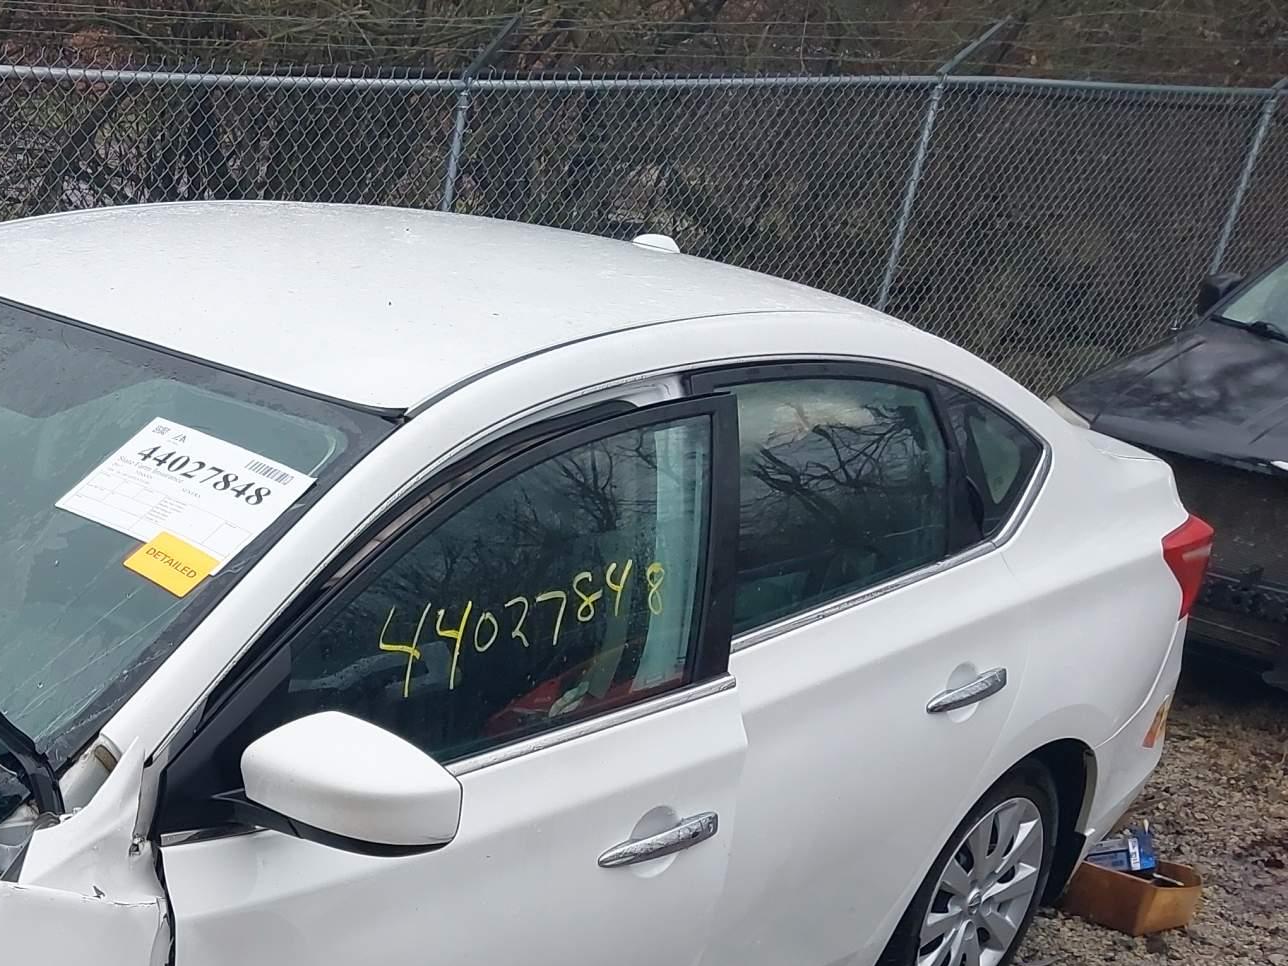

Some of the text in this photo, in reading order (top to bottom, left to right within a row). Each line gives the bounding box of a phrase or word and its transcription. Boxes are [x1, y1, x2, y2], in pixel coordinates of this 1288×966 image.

[137, 445, 271, 506] 44027848
[145, 547, 197, 579] DETAILED
[378, 559, 665, 698] 44027848
